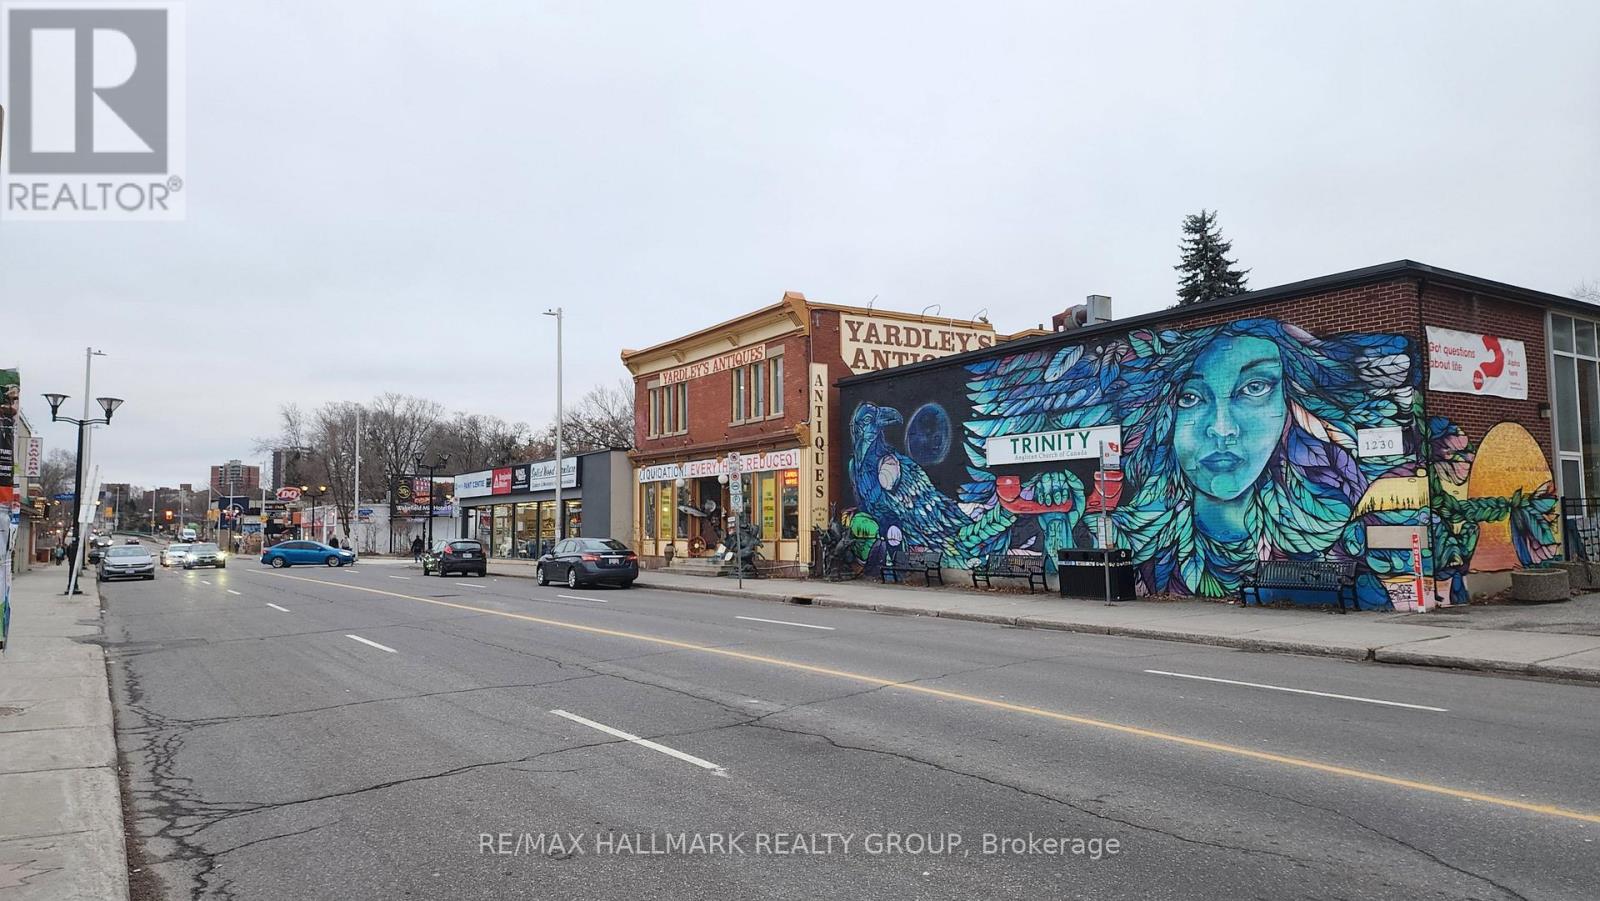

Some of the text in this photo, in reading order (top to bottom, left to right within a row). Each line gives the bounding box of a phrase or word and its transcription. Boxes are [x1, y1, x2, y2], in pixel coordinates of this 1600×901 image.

[845, 319, 992, 352] YARDLEY'S
[1429, 341, 1476, 359] Got questions
[663, 346, 763, 384] YARDLEY'S ANTIQUES
[1428, 358, 1450, 370] about
[814, 373, 825, 499] ANTIQUES
[1010, 431, 1092, 454] TRINITY
[1365, 439, 1394, 450] 1230
[1015, 453, 1039, 461] Anglican
[1039, 452, 1058, 460] Church
[280, 489, 298, 499] DQ
